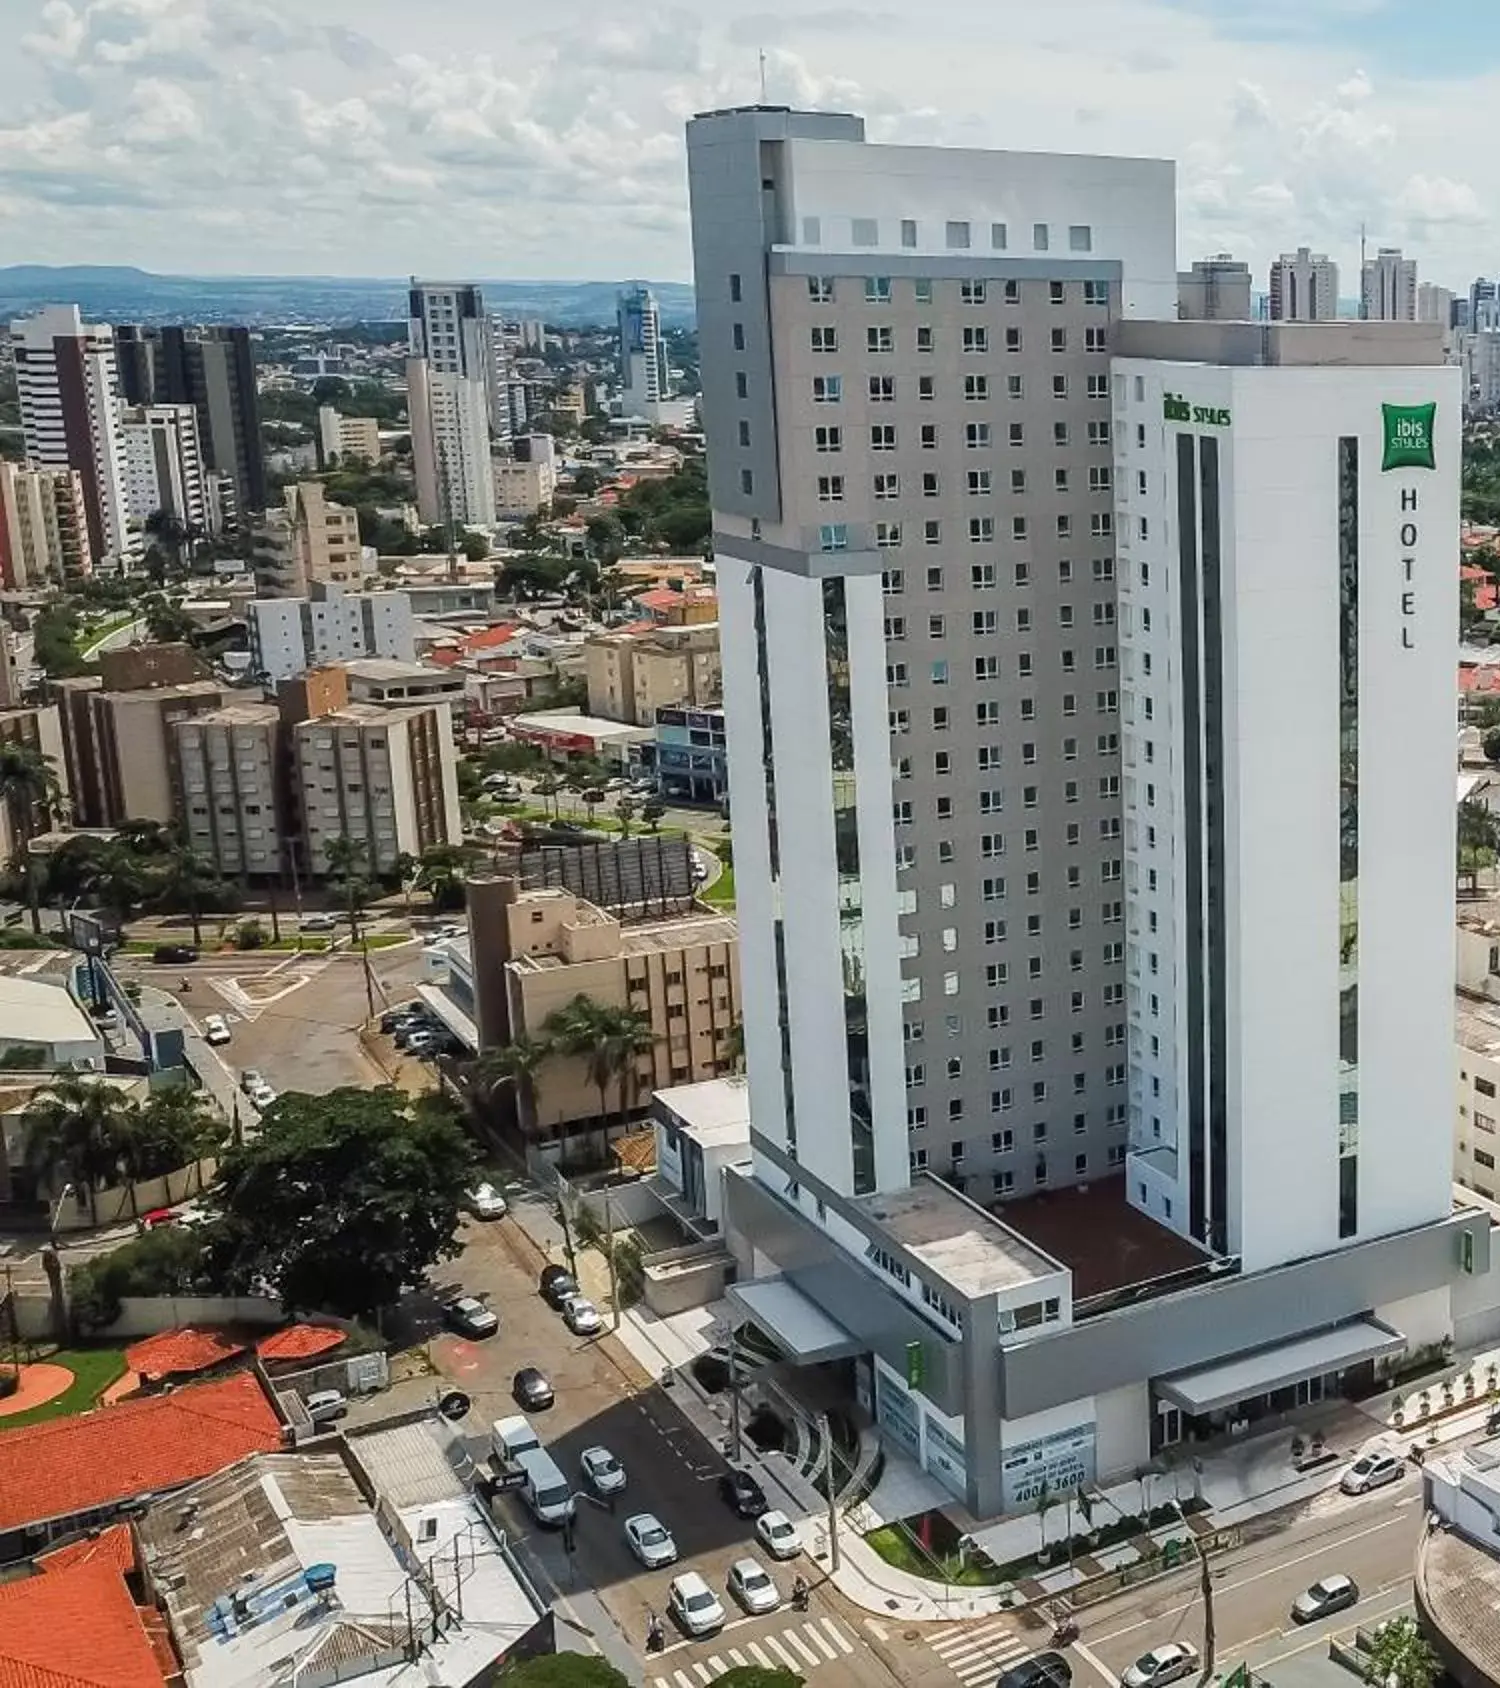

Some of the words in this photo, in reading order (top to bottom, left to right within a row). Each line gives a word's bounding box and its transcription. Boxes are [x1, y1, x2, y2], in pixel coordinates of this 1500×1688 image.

[1163, 393, 1190, 421] ibis
[1193, 406, 1231, 426] STYLES
[1397, 417, 1424, 437] ibis
[1391, 437, 1429, 449] STYLES
[1401, 488, 1418, 649] HOTEL
